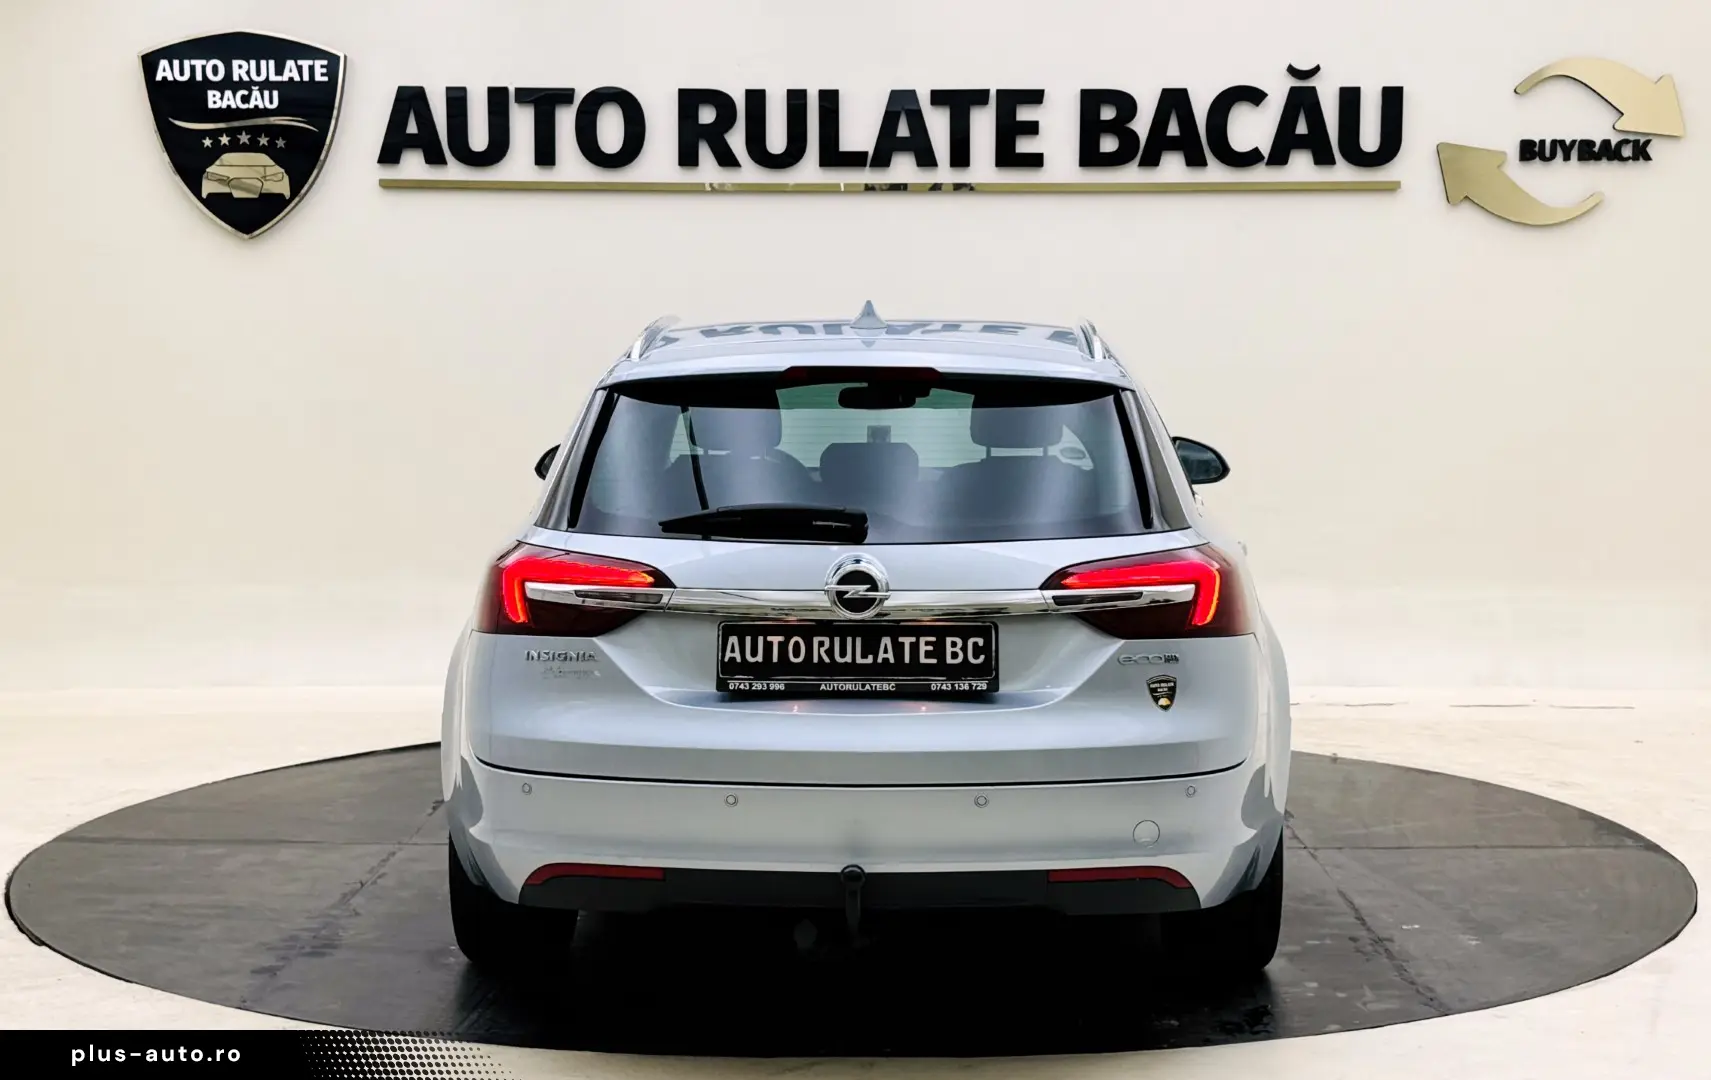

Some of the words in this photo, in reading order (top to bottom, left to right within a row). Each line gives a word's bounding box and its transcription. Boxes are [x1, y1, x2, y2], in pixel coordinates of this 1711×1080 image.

[155, 58, 226, 82] AUTO
[232, 59, 328, 82] RULATE
[207, 85, 279, 110] BACĂU
[377, 85, 646, 169] AUTO
[677, 88, 1046, 169] RULATE
[1078, 63, 1404, 169] BACĂU
[1518, 138, 1653, 163] BUYBACK
[525, 650, 598, 662] INSIGNIA
[945, 636, 986, 665] BC
[728, 682, 750, 690] 0743
[751, 682, 768, 691] 293
[769, 682, 786, 691] 996
[819, 682, 896, 691] AUTORULATEBC
[930, 682, 952, 691] 0743
[971, 682, 988, 691] 729
